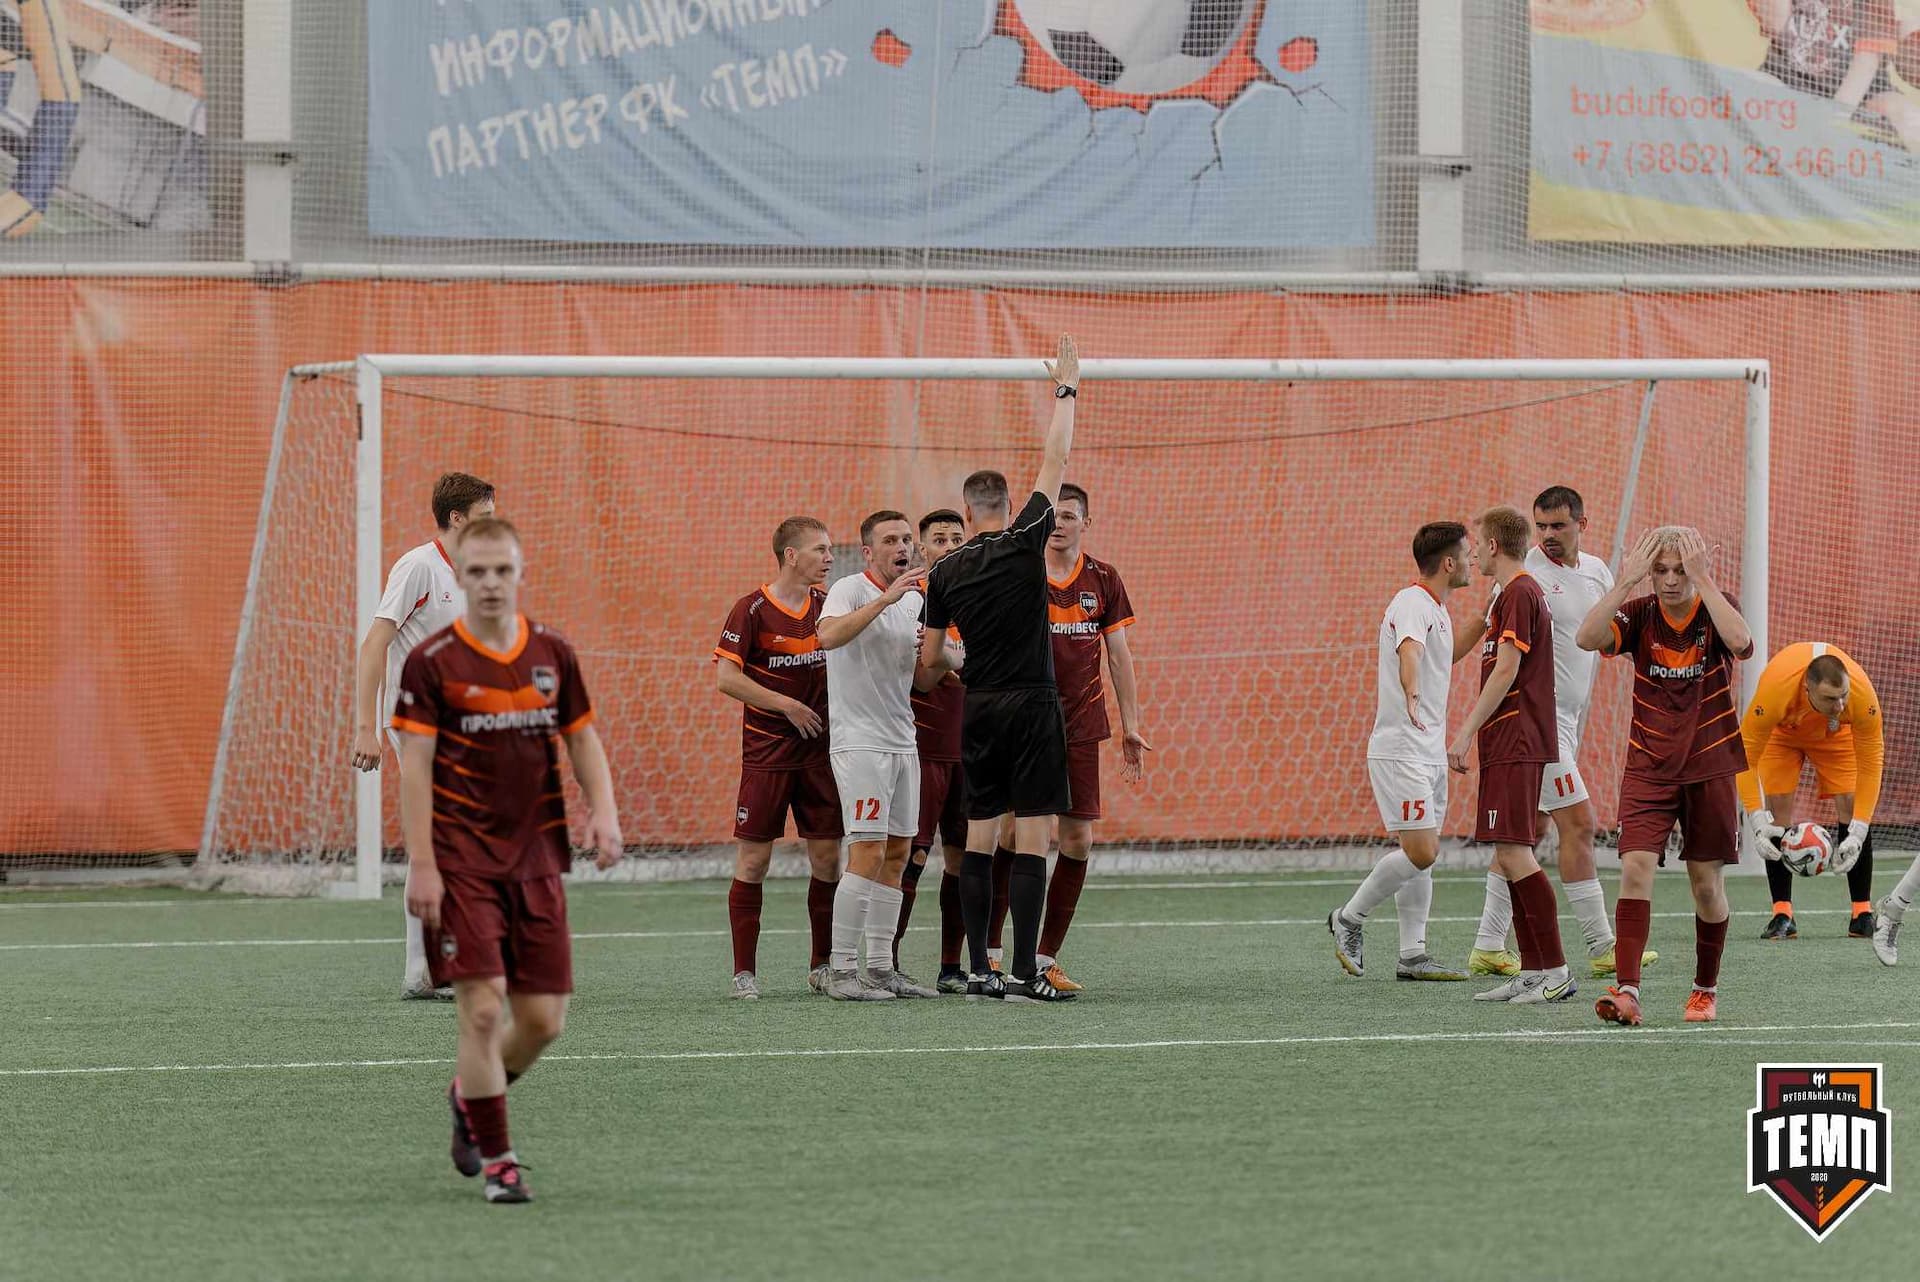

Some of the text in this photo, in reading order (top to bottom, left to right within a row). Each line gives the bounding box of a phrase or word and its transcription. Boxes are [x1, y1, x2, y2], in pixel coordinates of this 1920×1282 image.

[427, 44, 849, 180] ПАРТНЕР ФК «ТЕМП»
[1570, 84, 1798, 129] budufood.org
[1573, 141, 1886, 179] +7 (3852) 22-66-01
[721, 630, 741, 644] ПСБ
[1554, 773, 1575, 798] 11
[855, 797, 881, 821] 12
[1401, 799, 1426, 822] 15
[1487, 809, 1499, 830] 17
